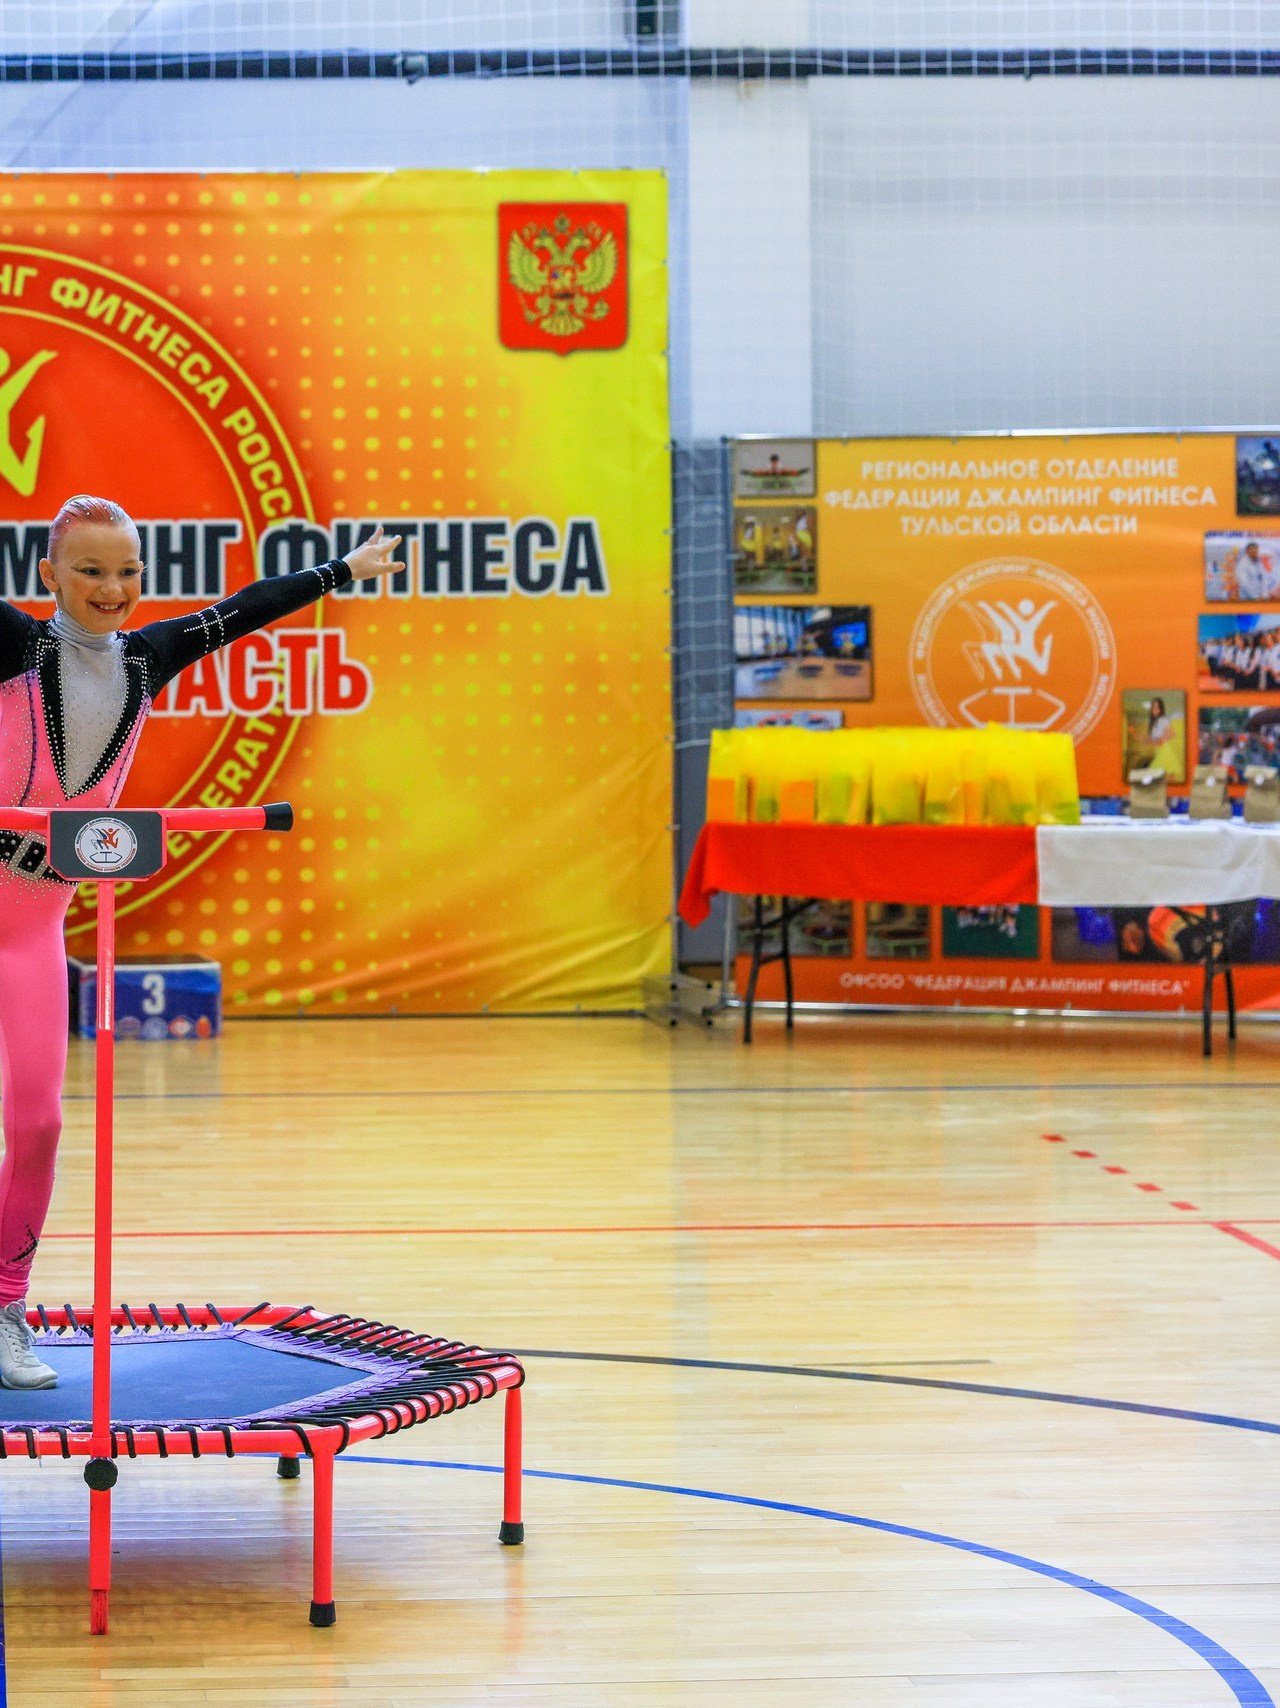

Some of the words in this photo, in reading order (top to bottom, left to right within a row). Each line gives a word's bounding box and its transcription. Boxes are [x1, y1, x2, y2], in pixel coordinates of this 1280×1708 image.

[50, 277, 230, 410] ФИТНЕСА
[222, 406, 294, 524] РОСС
[861, 458, 1040, 481] РЕГИОНАЛЬНОЕ
[1046, 457, 1179, 481] ОТДЕЛЕНИЕ
[966, 486, 1103, 508] ДЖАМПИНГ
[1108, 485, 1217, 506] ФИТНЕСА
[900, 511, 1020, 536] ТУЛЬСКОЙ
[1028, 514, 1138, 535] ОБЛАСТИ
[142, 973, 166, 1015] 3
